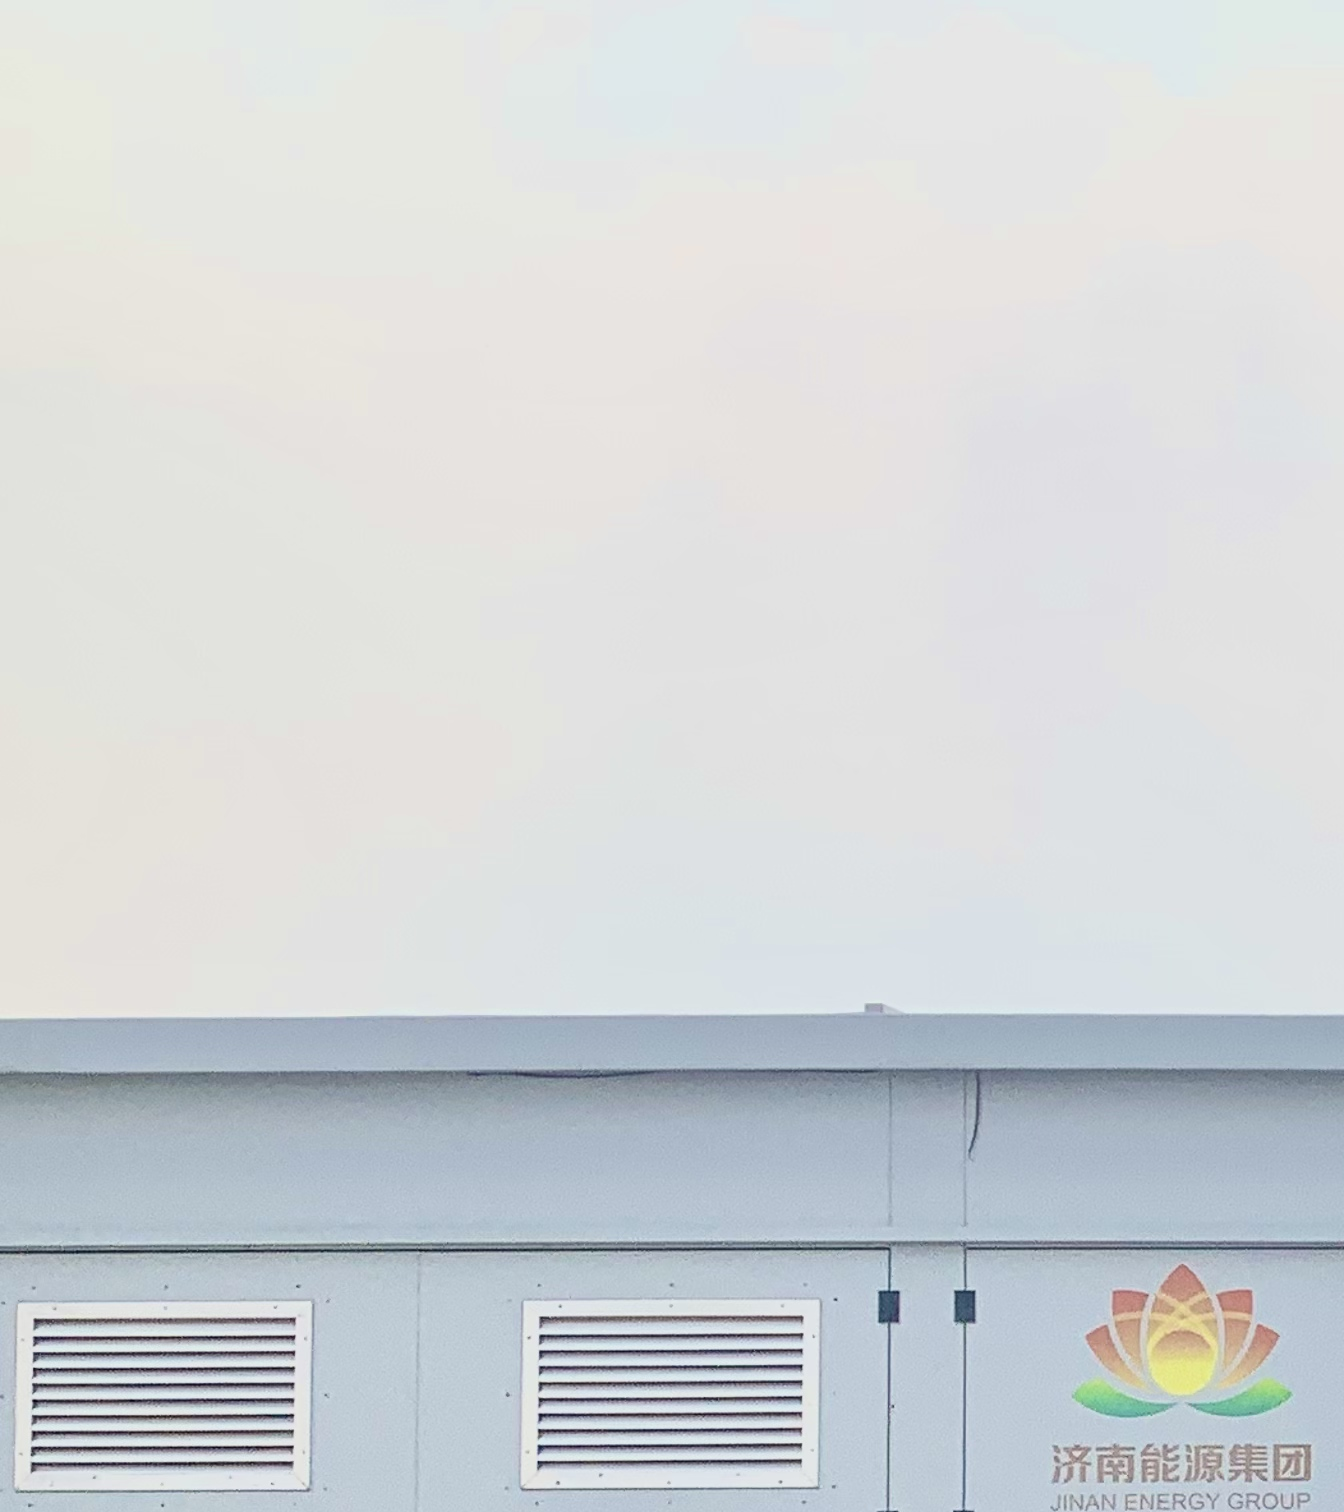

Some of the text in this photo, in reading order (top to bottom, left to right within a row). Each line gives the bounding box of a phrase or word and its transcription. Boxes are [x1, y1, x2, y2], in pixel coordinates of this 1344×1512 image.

[1051, 1443, 1312, 1484] 济南能源集团
[1050, 1492, 1311, 1512] JINAN ENERGY GROUP
